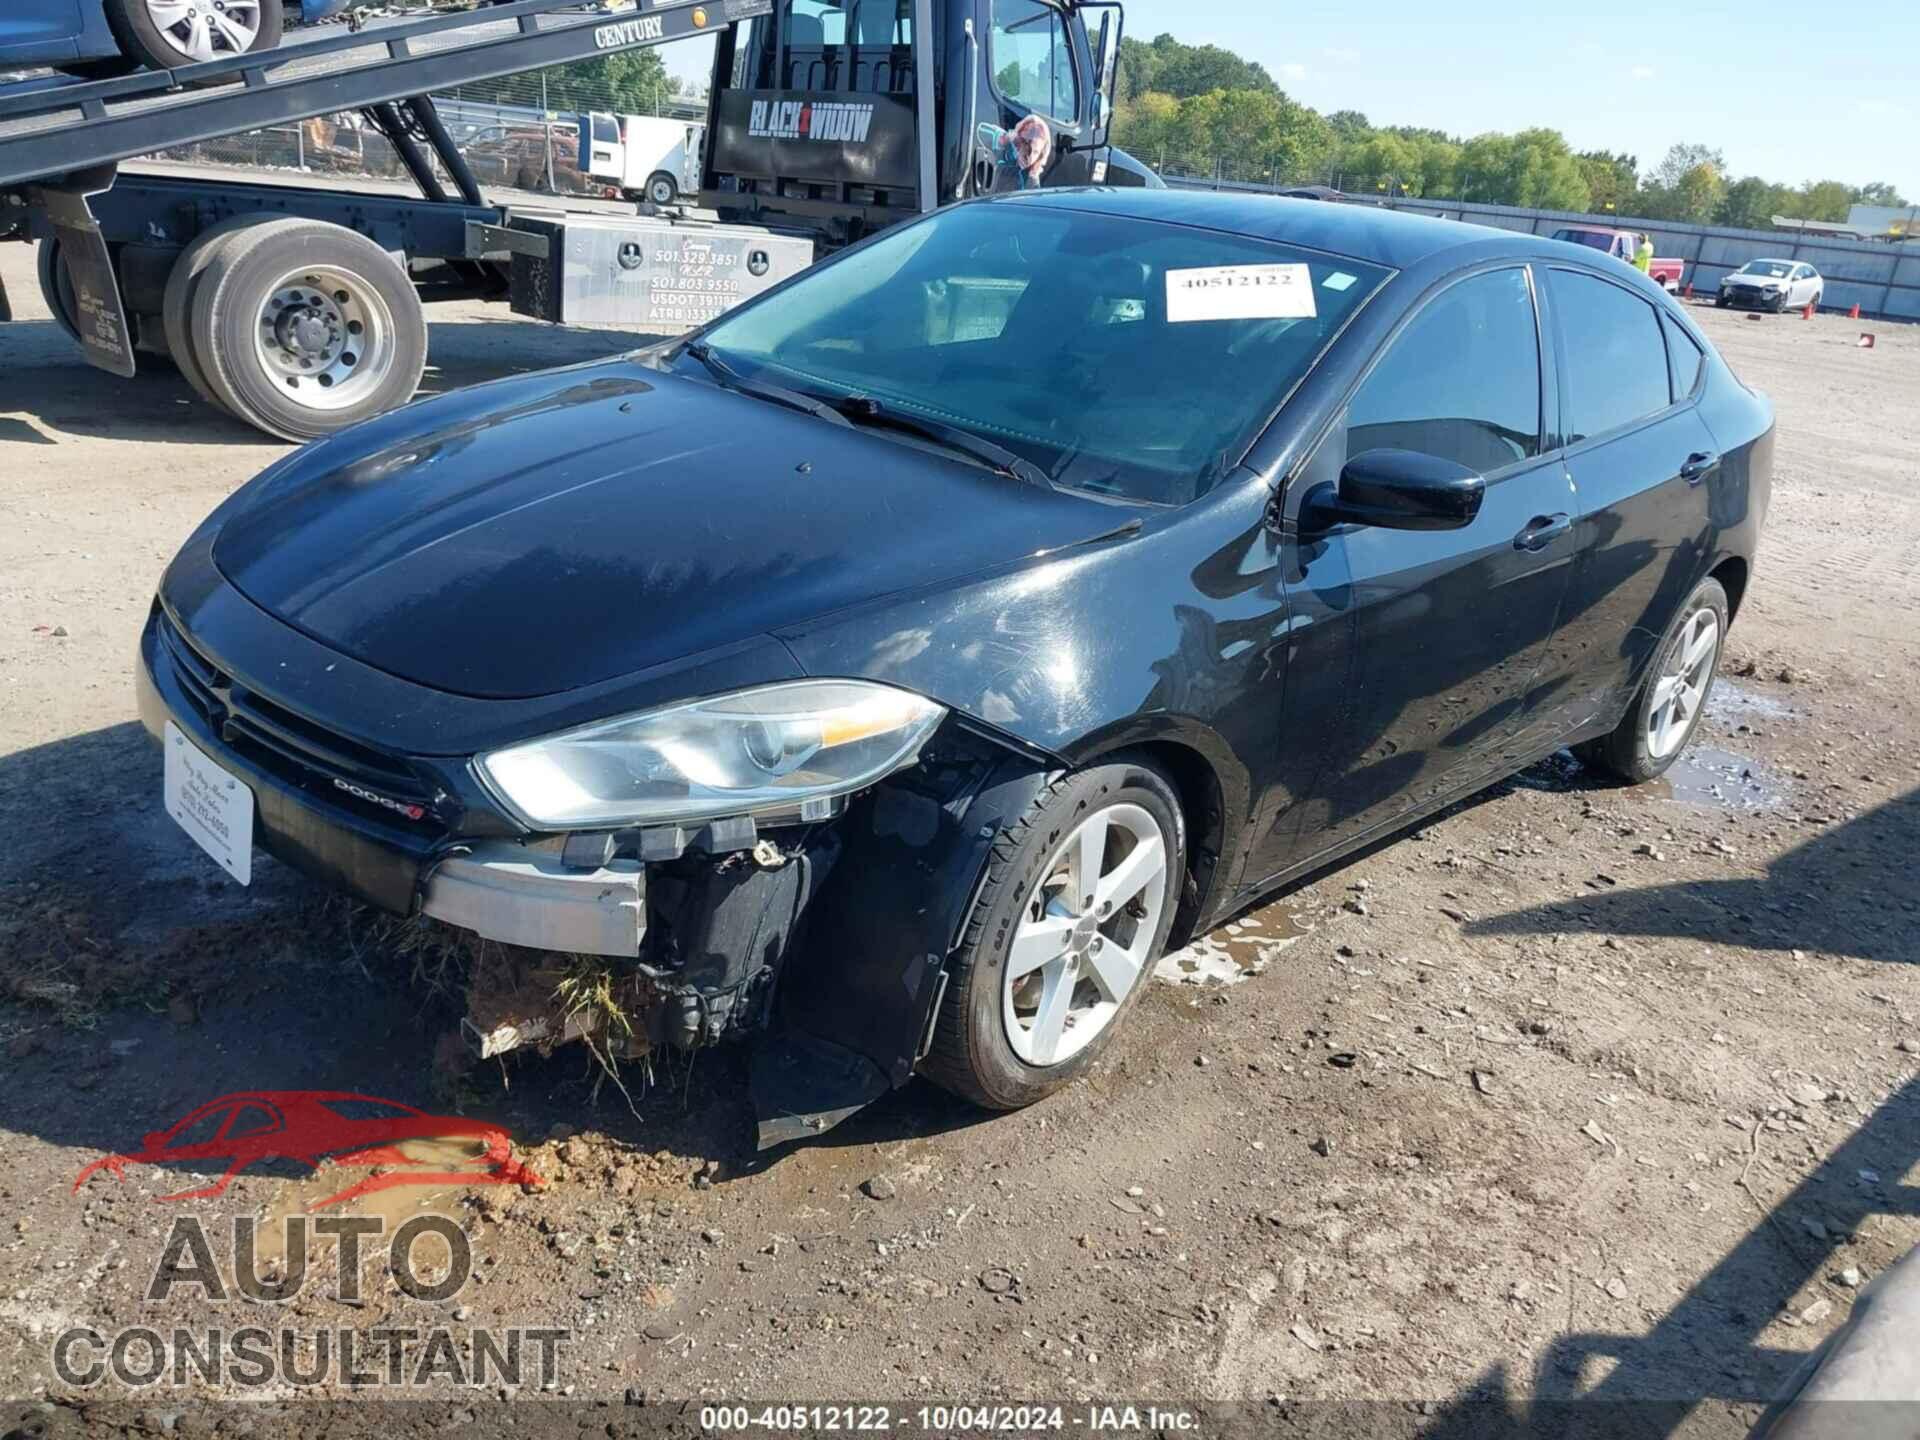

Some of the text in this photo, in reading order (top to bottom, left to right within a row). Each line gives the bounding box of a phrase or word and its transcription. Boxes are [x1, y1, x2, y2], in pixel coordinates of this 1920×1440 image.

[595, 16, 663, 49] CENTURY
[748, 100, 874, 142] BLACK WIDOW
[1182, 274, 1292, 289] 40512122
[650, 293, 696, 306] USDOT
[649, 307, 683, 320] ATRB
[333, 778, 407, 814] DODGE
